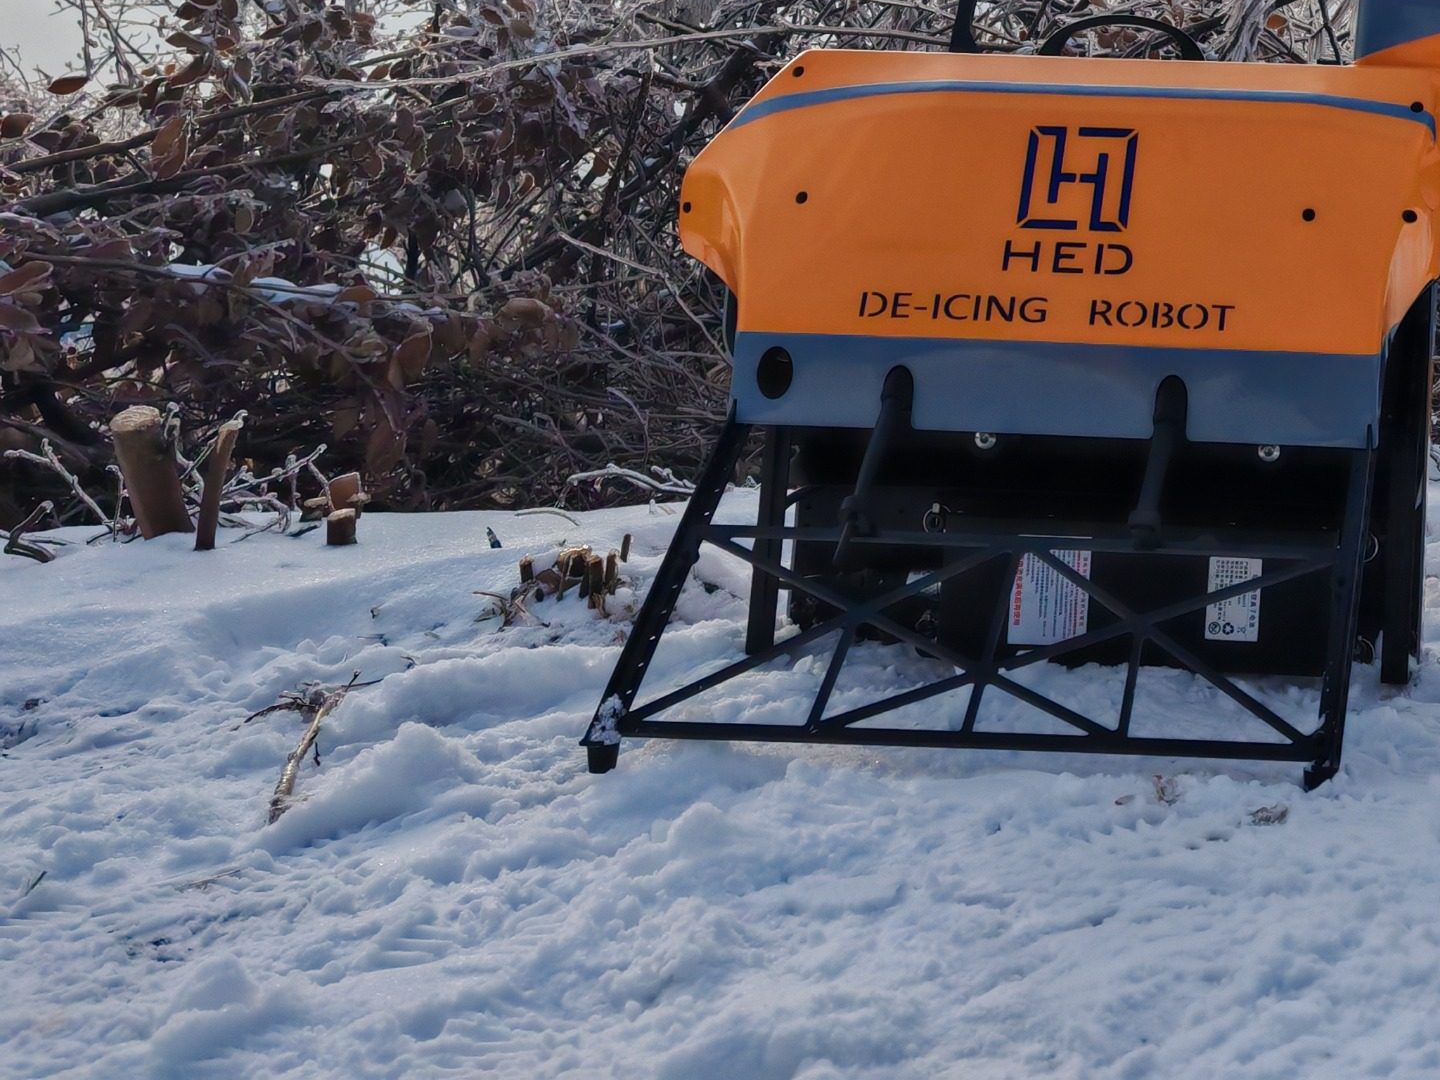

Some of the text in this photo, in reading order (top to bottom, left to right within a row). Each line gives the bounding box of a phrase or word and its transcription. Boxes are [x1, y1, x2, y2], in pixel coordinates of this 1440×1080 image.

[1002, 240, 1133, 275] HED
[859, 292, 1235, 331] DE-ICING ROBOT
